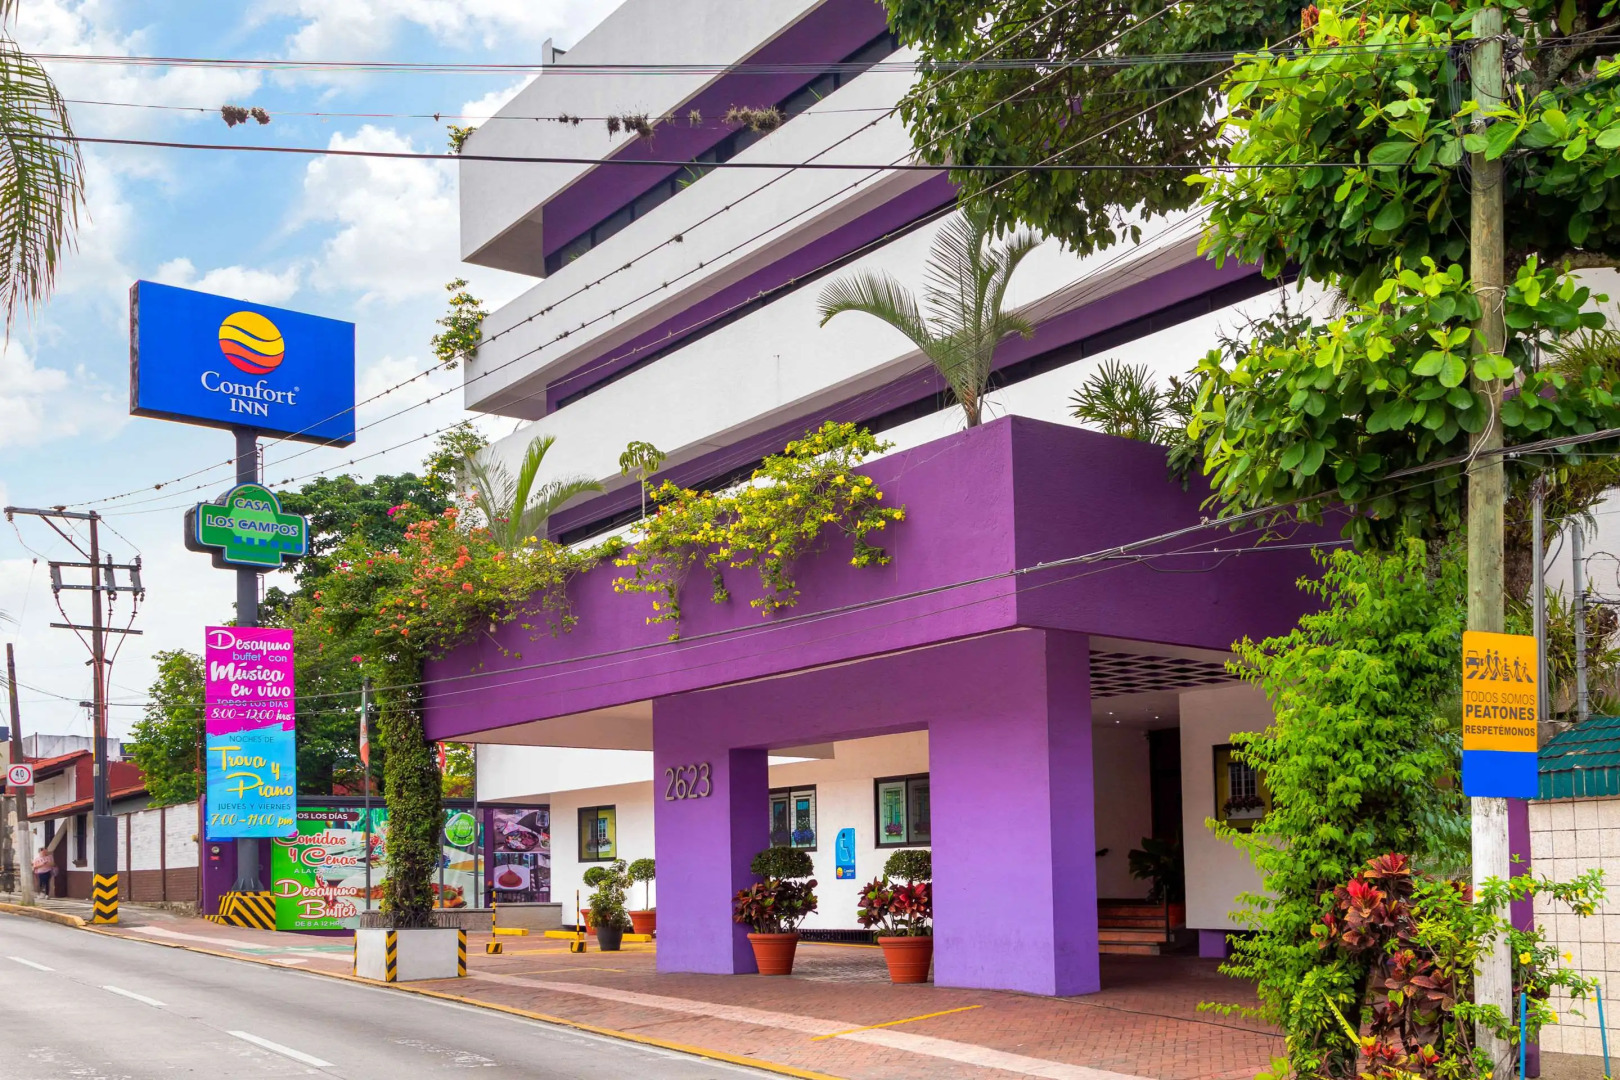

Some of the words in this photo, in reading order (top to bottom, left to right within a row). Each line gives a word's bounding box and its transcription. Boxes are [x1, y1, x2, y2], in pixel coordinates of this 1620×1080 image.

[201, 370, 297, 405] Comfort
[230, 397, 269, 417] INN
[234, 498, 271, 512] CASA
[206, 514, 234, 528] LOS
[238, 519, 298, 536] CAMPOS
[207, 629, 291, 656] Desayuno
[232, 651, 261, 661] buffet
[210, 660, 285, 682] Música
[231, 683, 252, 697] en
[257, 682, 291, 697] vivo
[1465, 690, 1499, 704] TODOS
[1501, 692, 1535, 706] SOMOS
[217, 698, 247, 707] TODOS
[250, 700, 267, 708] LOS
[1465, 704, 1535, 720] PEATONES
[229, 735, 262, 743] NOCHES
[1465, 724, 1535, 737] RESPETÉMONOS
[208, 746, 267, 771] Trova
[15, 769, 25, 778] 40
[664, 762, 711, 801] 2623
[226, 772, 293, 799] Piano
[277, 816, 294, 829] pm
[328, 811, 348, 820] DÍAS
[301, 846, 358, 866] Cenas
[274, 878, 357, 901] Desayuno
[297, 899, 357, 919] Buffet
